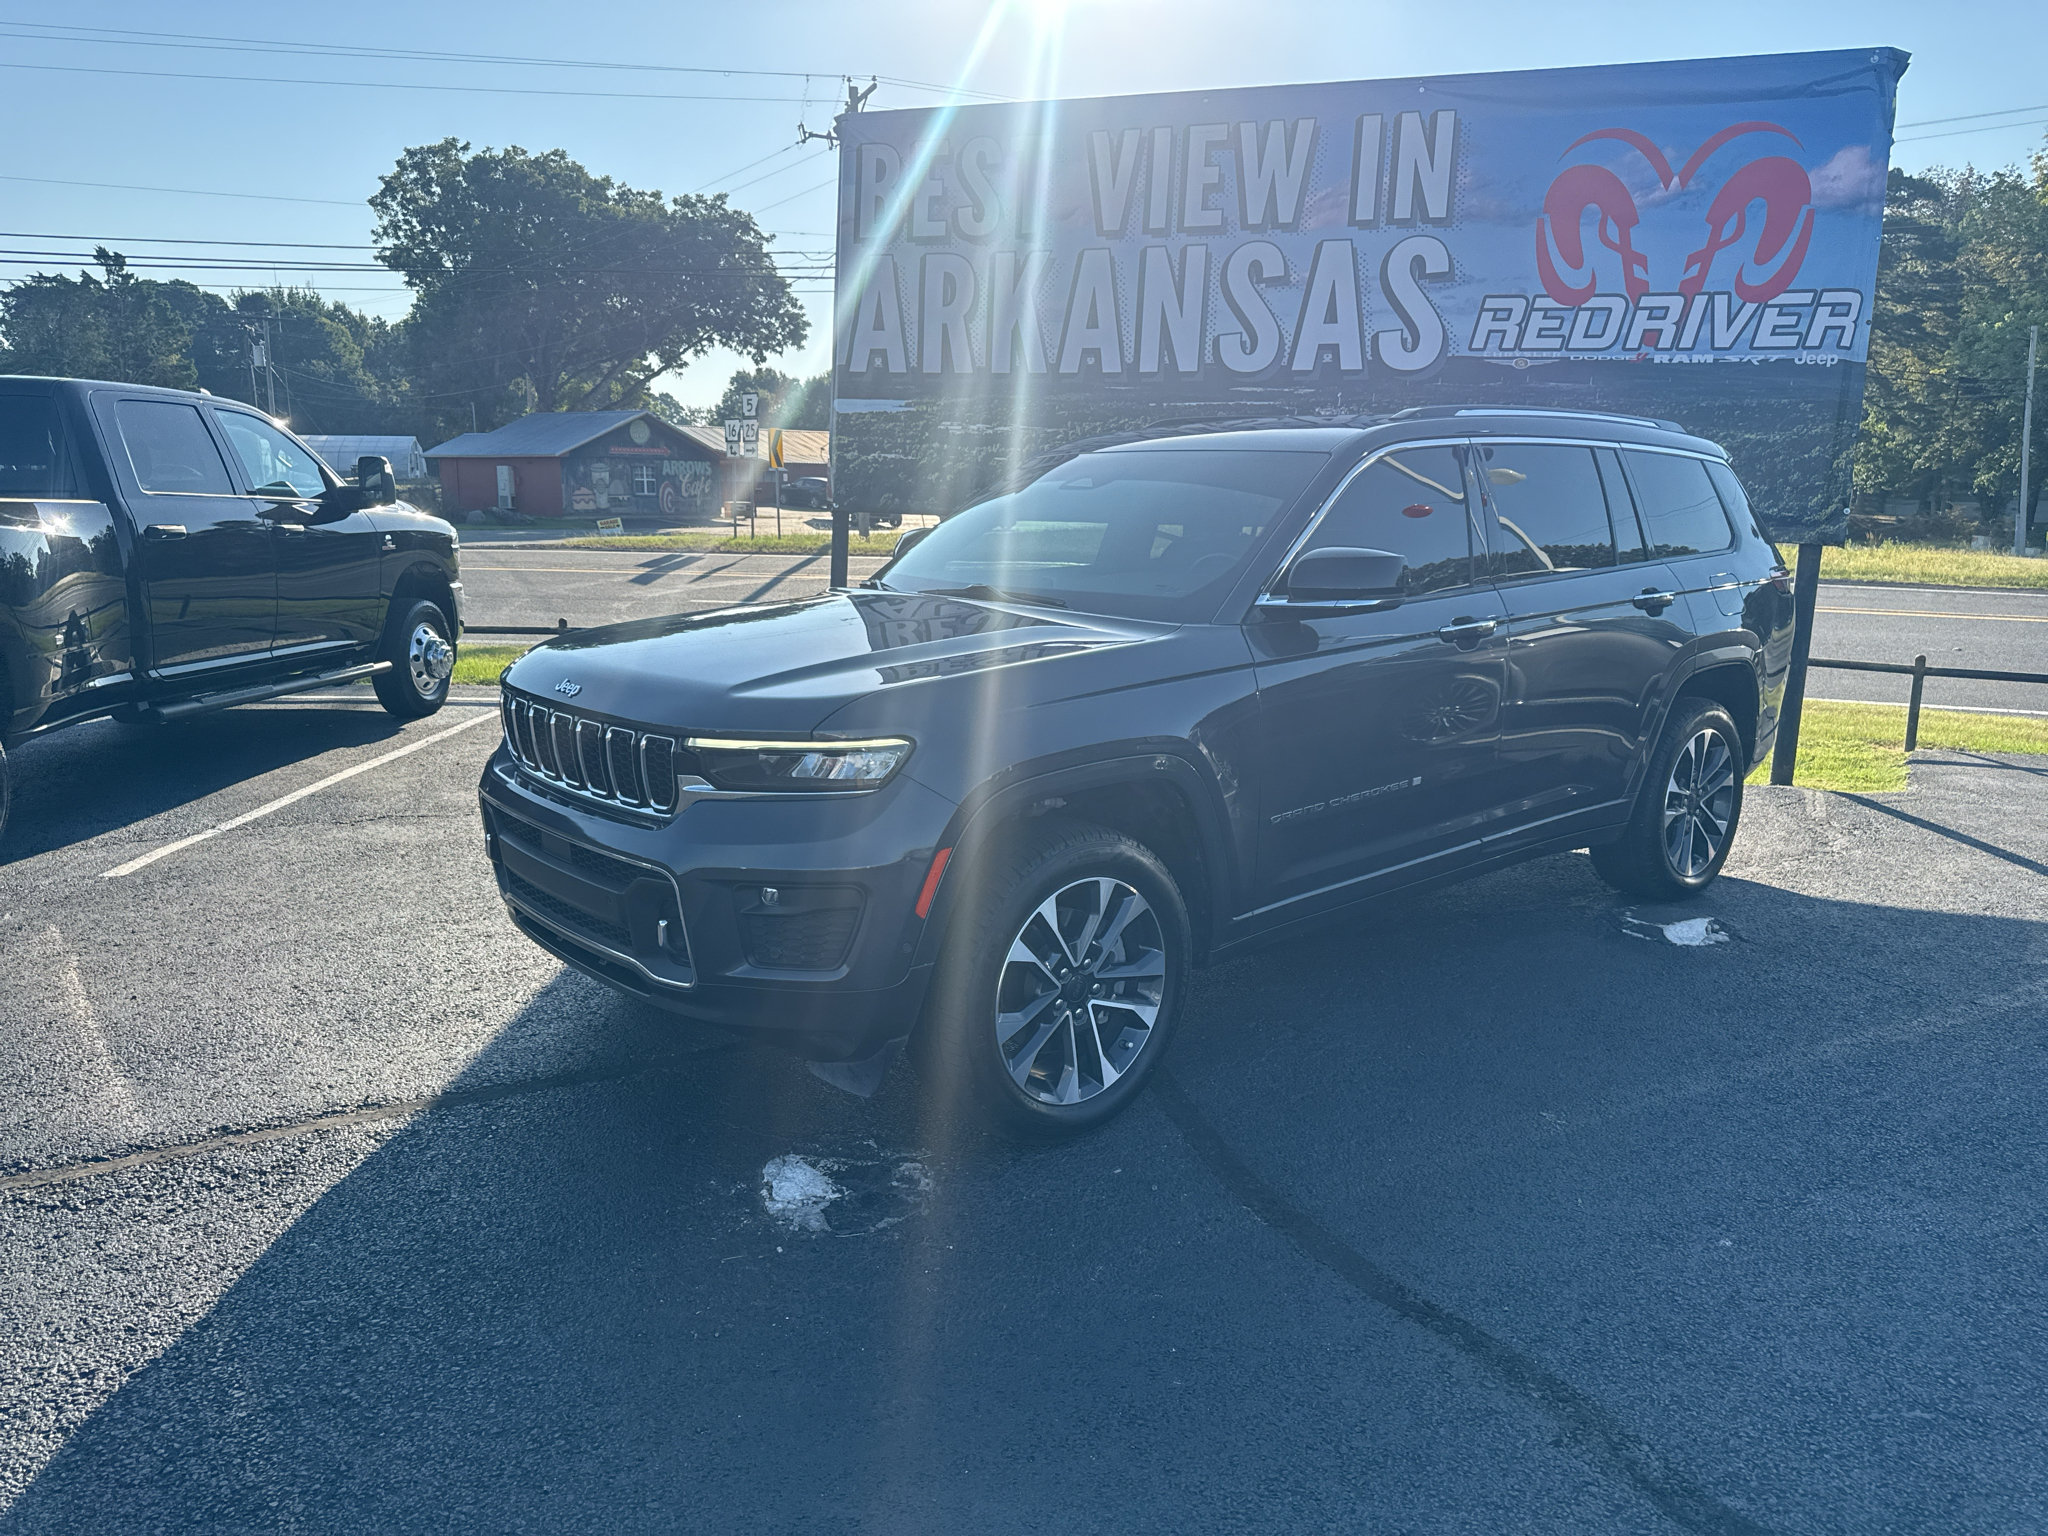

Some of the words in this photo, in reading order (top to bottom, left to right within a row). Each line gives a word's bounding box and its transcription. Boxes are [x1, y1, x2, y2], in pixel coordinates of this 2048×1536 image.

[854, 132, 1060, 245] BEST
[1087, 117, 1320, 239] VIEW
[1349, 109, 1458, 227] IN
[846, 235, 1456, 378] ARKANSAS
[1569, 353, 1638, 361] DODGE
[1653, 353, 1714, 364] RAM
[1719, 354, 1787, 365] SRT
[1794, 350, 1839, 368] Jeep
[746, 398, 753, 413] 5
[728, 424, 737, 438] 16
[745, 423, 755, 438] 25
[662, 460, 712, 476] ARROWS
[555, 678, 582, 698] Jeep
[1329, 779, 1409, 807] CHEROKEE
